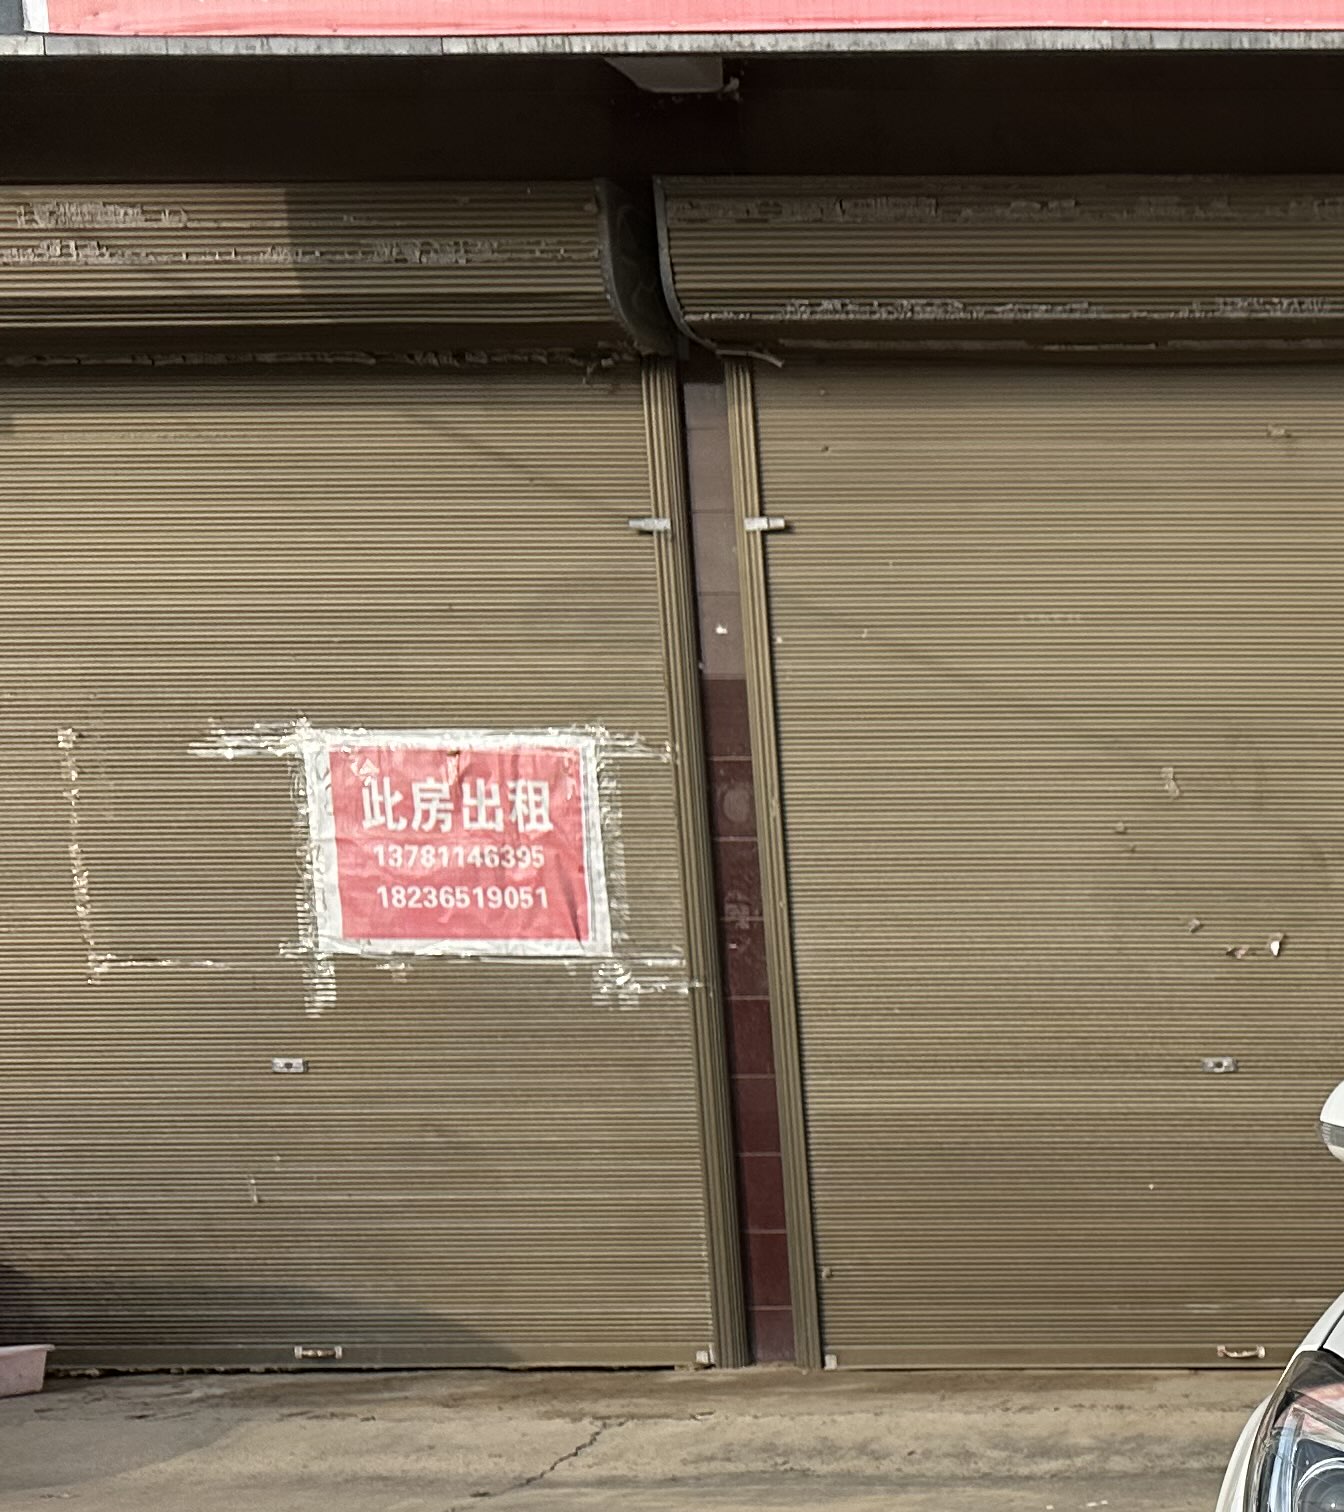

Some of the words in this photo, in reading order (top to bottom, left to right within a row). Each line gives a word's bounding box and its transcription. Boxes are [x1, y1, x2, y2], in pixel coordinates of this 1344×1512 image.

[362, 776, 554, 833] 此房出租
[373, 844, 545, 869] 13781146395
[376, 885, 549, 909] 18236519051
